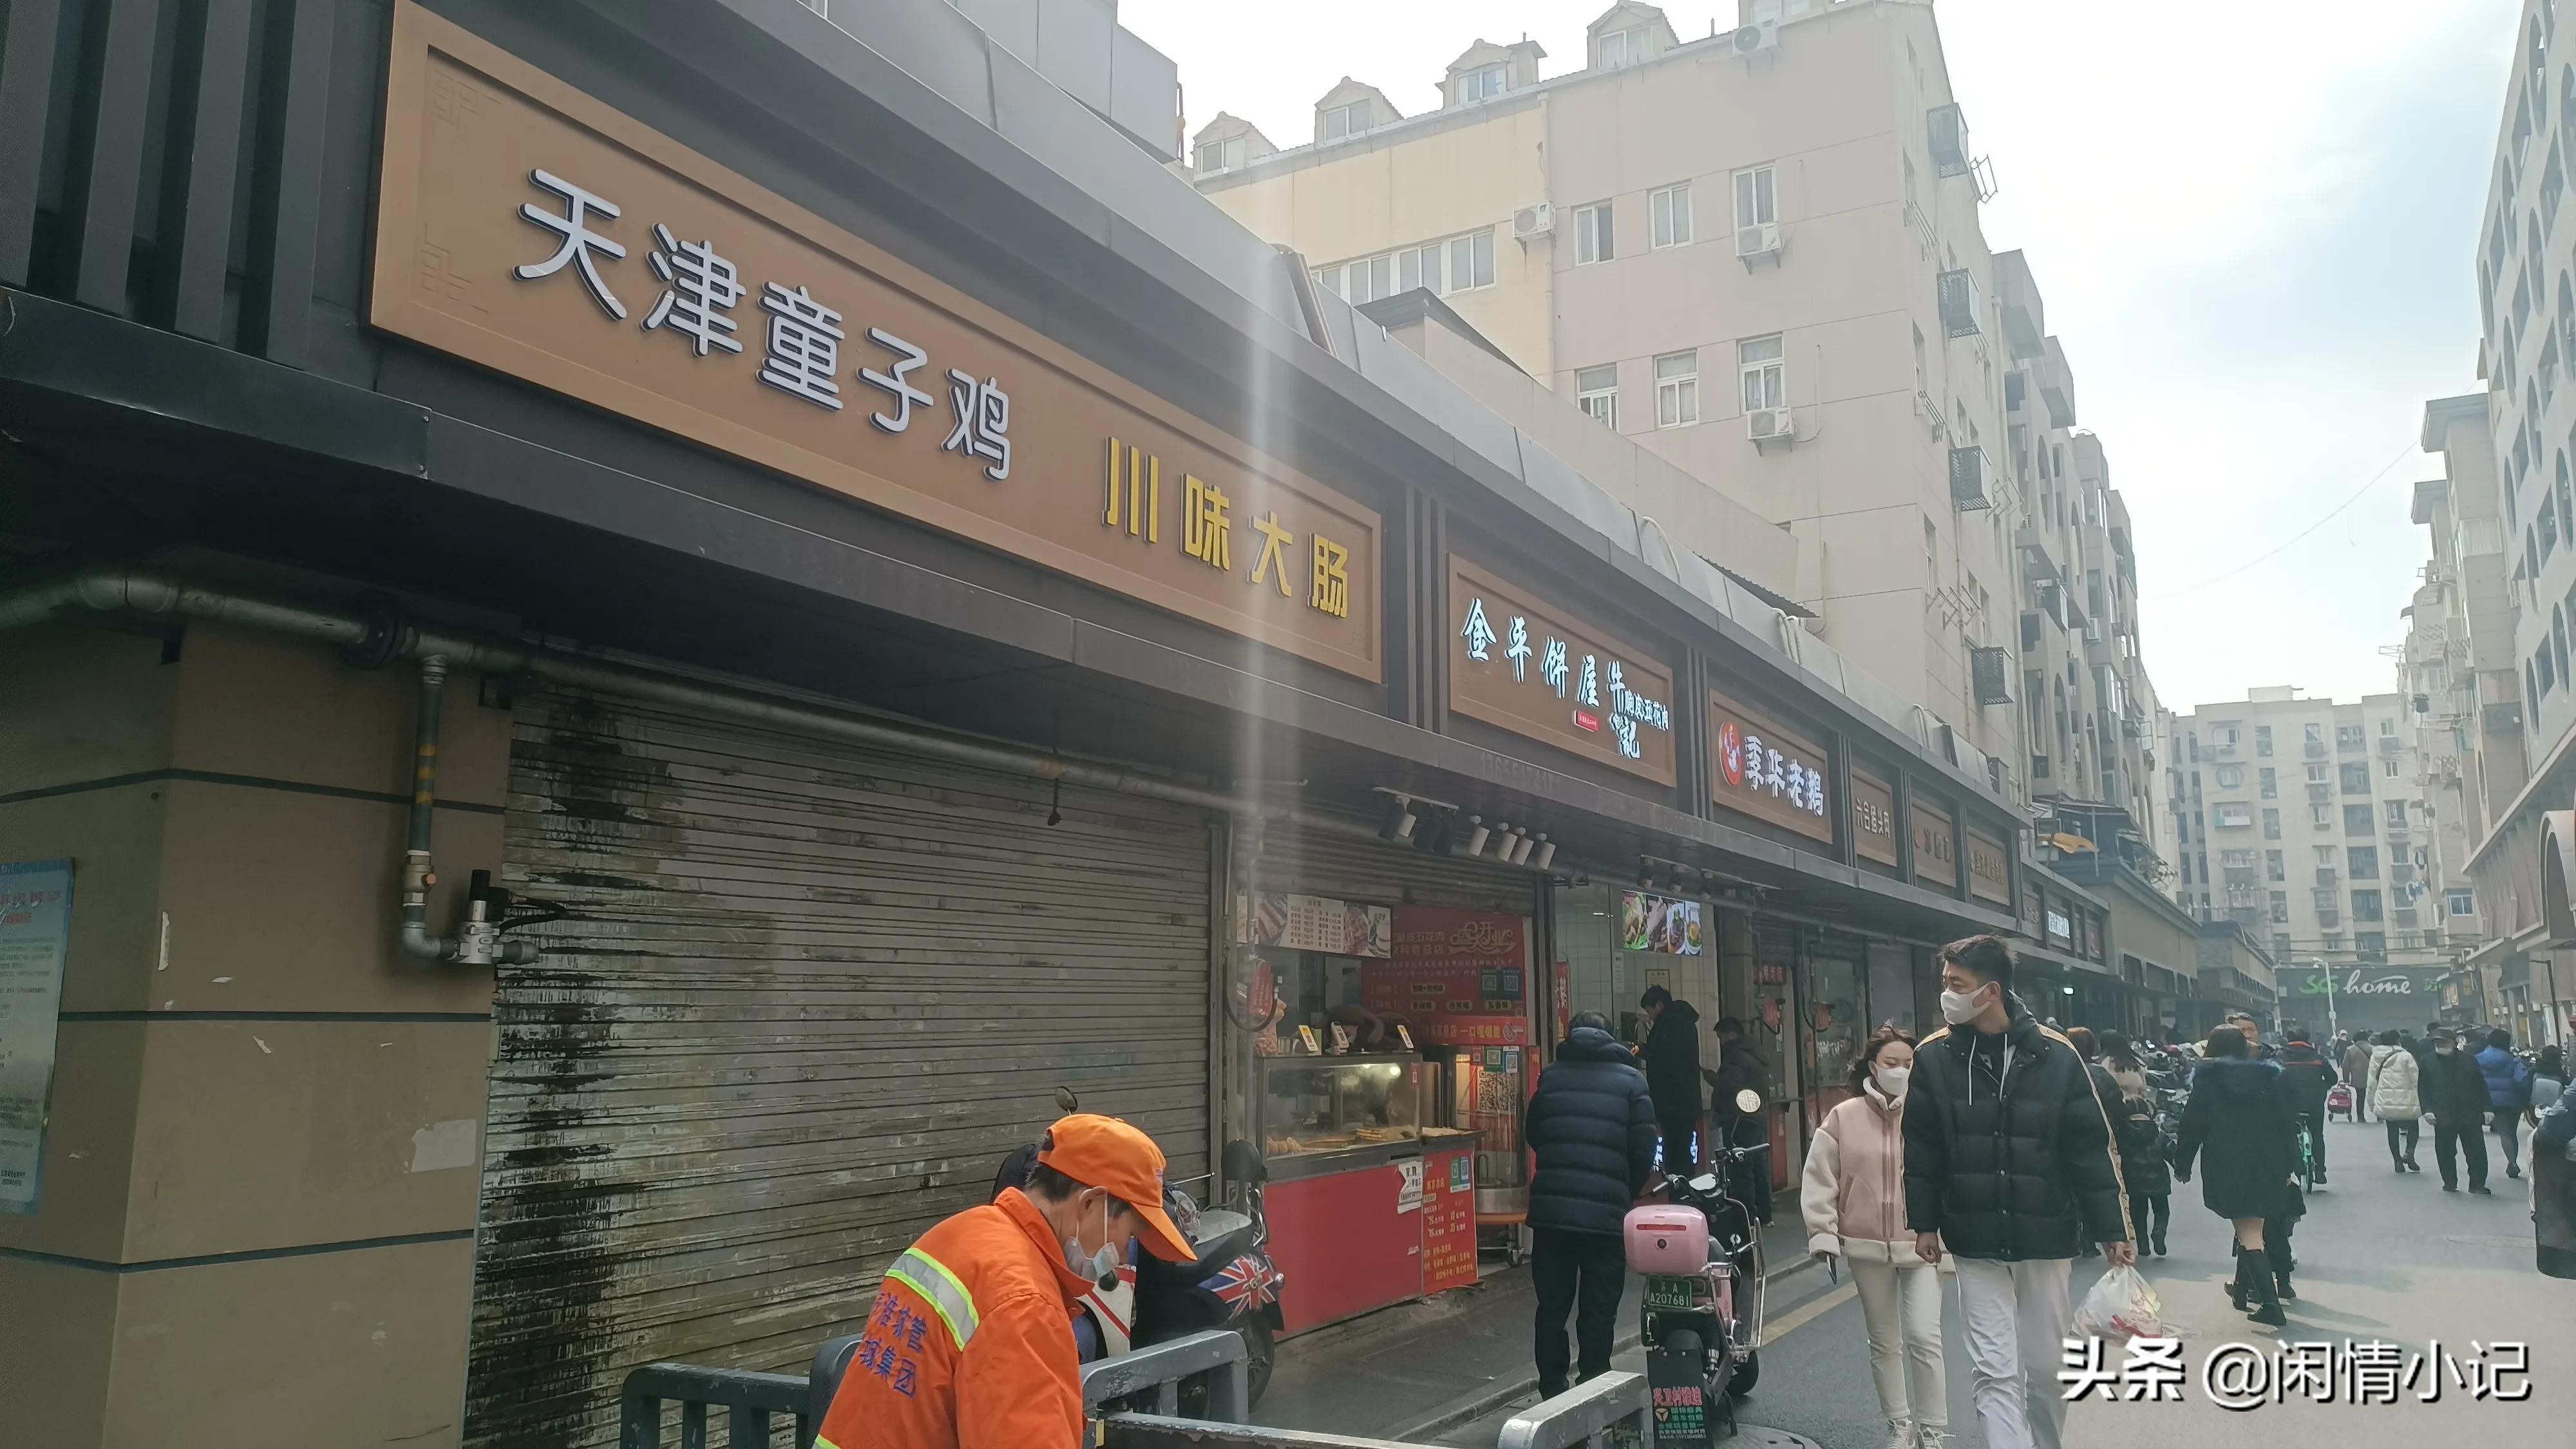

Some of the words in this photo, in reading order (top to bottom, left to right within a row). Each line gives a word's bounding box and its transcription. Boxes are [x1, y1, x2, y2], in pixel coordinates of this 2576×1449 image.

[512, 167, 1012, 482] 天津童子鸡
[1101, 436, 1349, 619] 川味大肠
[1460, 597, 1600, 708] 金平饼屋
[2342, 969, 2412, 995] home
[1650, 1292, 1689, 1307] A207681
